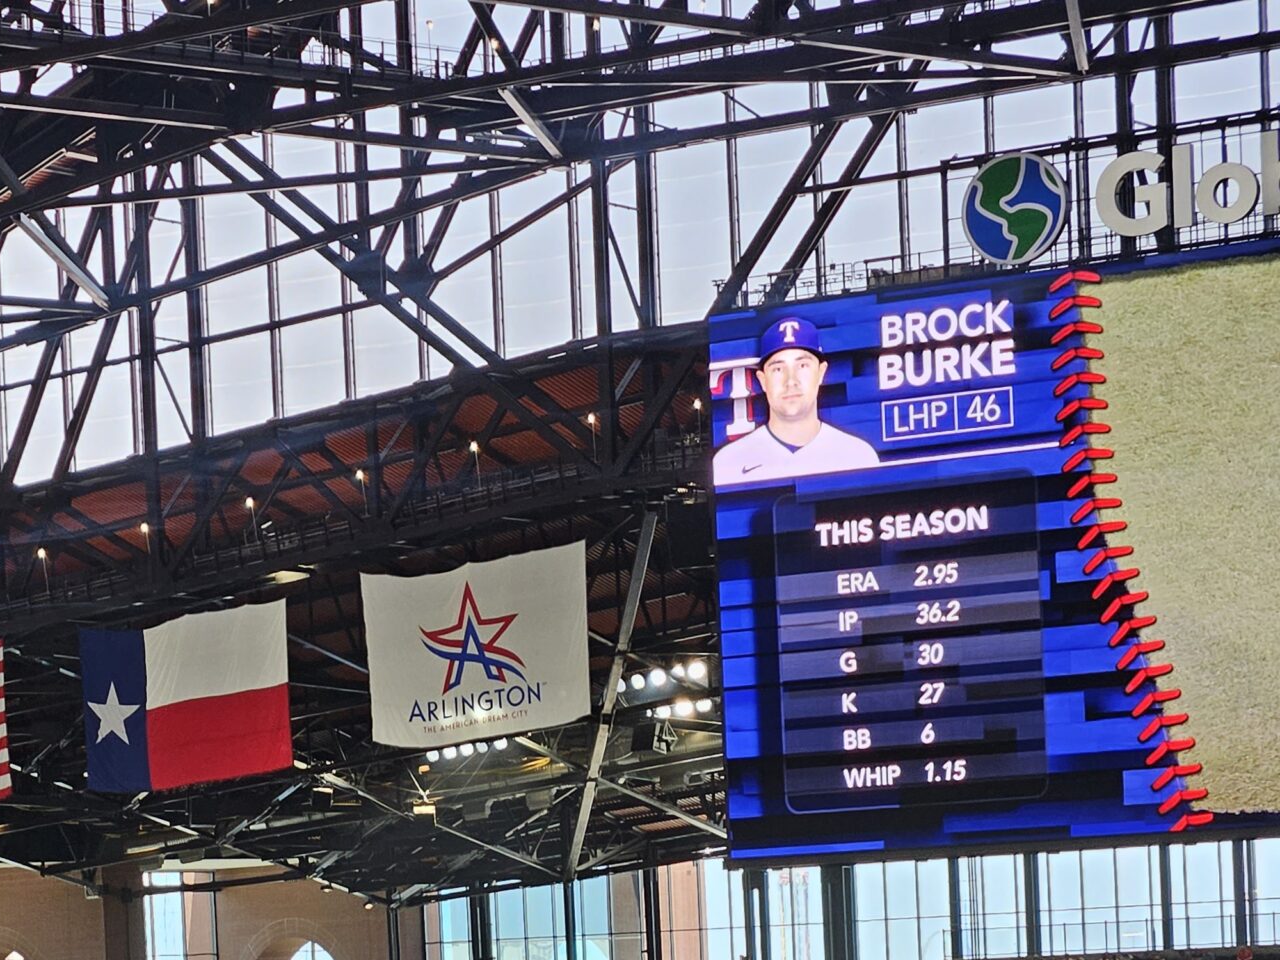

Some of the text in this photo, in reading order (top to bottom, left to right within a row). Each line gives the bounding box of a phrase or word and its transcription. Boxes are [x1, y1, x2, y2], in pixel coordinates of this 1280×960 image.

[881, 300, 1012, 348] BROCK
[878, 339, 1016, 389] BURKE
[893, 393, 1001, 433] LHP 46
[815, 505, 989, 547] THIS SEASON
[837, 562, 959, 594] ERA 2.95
[838, 601, 960, 632] IP 36.2
[839, 643, 944, 673] G 30
[408, 682, 542, 723] ARLINGTON
[841, 682, 945, 713] K 27
[423, 725, 437, 734] THE
[440, 718, 479, 733] AMERICAN
[511, 709, 529, 719] CITY
[842, 722, 935, 751] BB 6
[843, 760, 967, 789] WHIP 1.15
